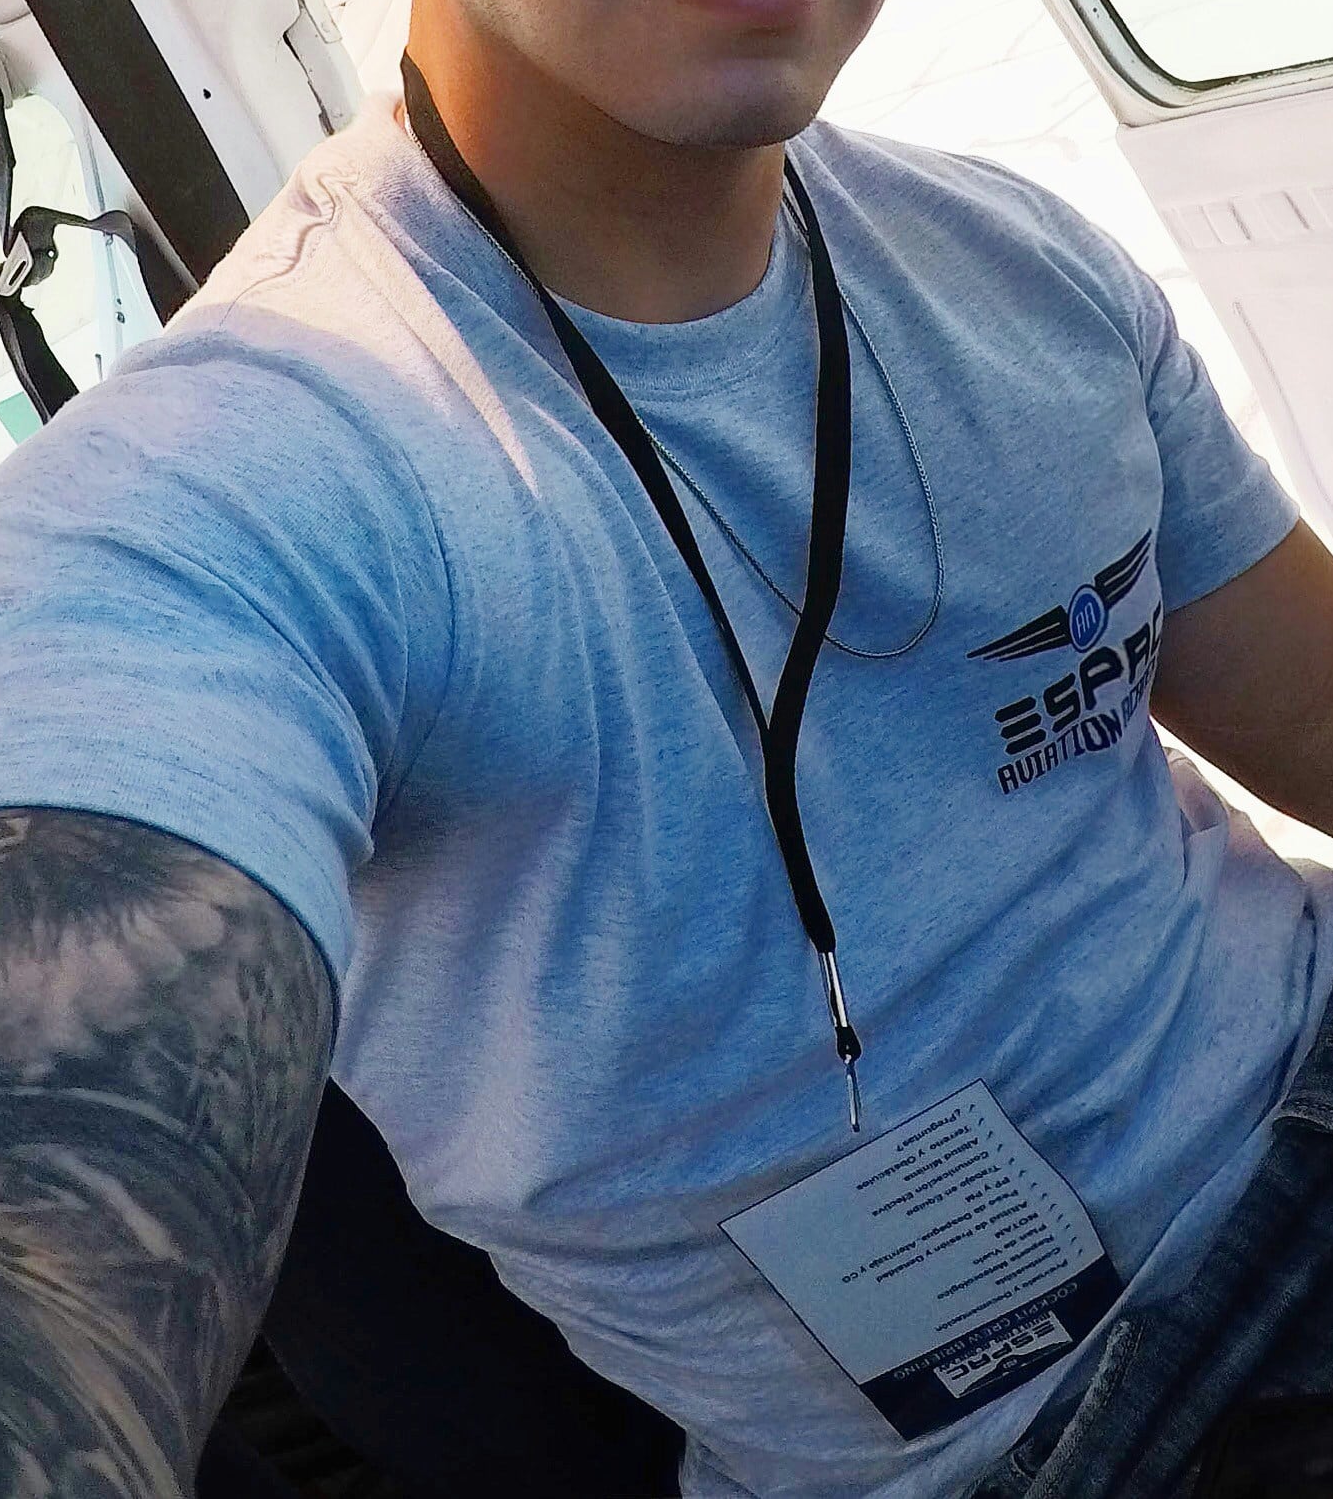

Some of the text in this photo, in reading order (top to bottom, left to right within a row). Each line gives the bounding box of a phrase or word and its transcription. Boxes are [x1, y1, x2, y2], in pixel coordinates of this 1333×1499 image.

[998, 708, 1123, 795] AVIATION
[895, 1109, 961, 1151] ¿Preguntas?
[995, 1212, 1037, 1238] NOTAM
[947, 1318, 1054, 1383] ESPAC
